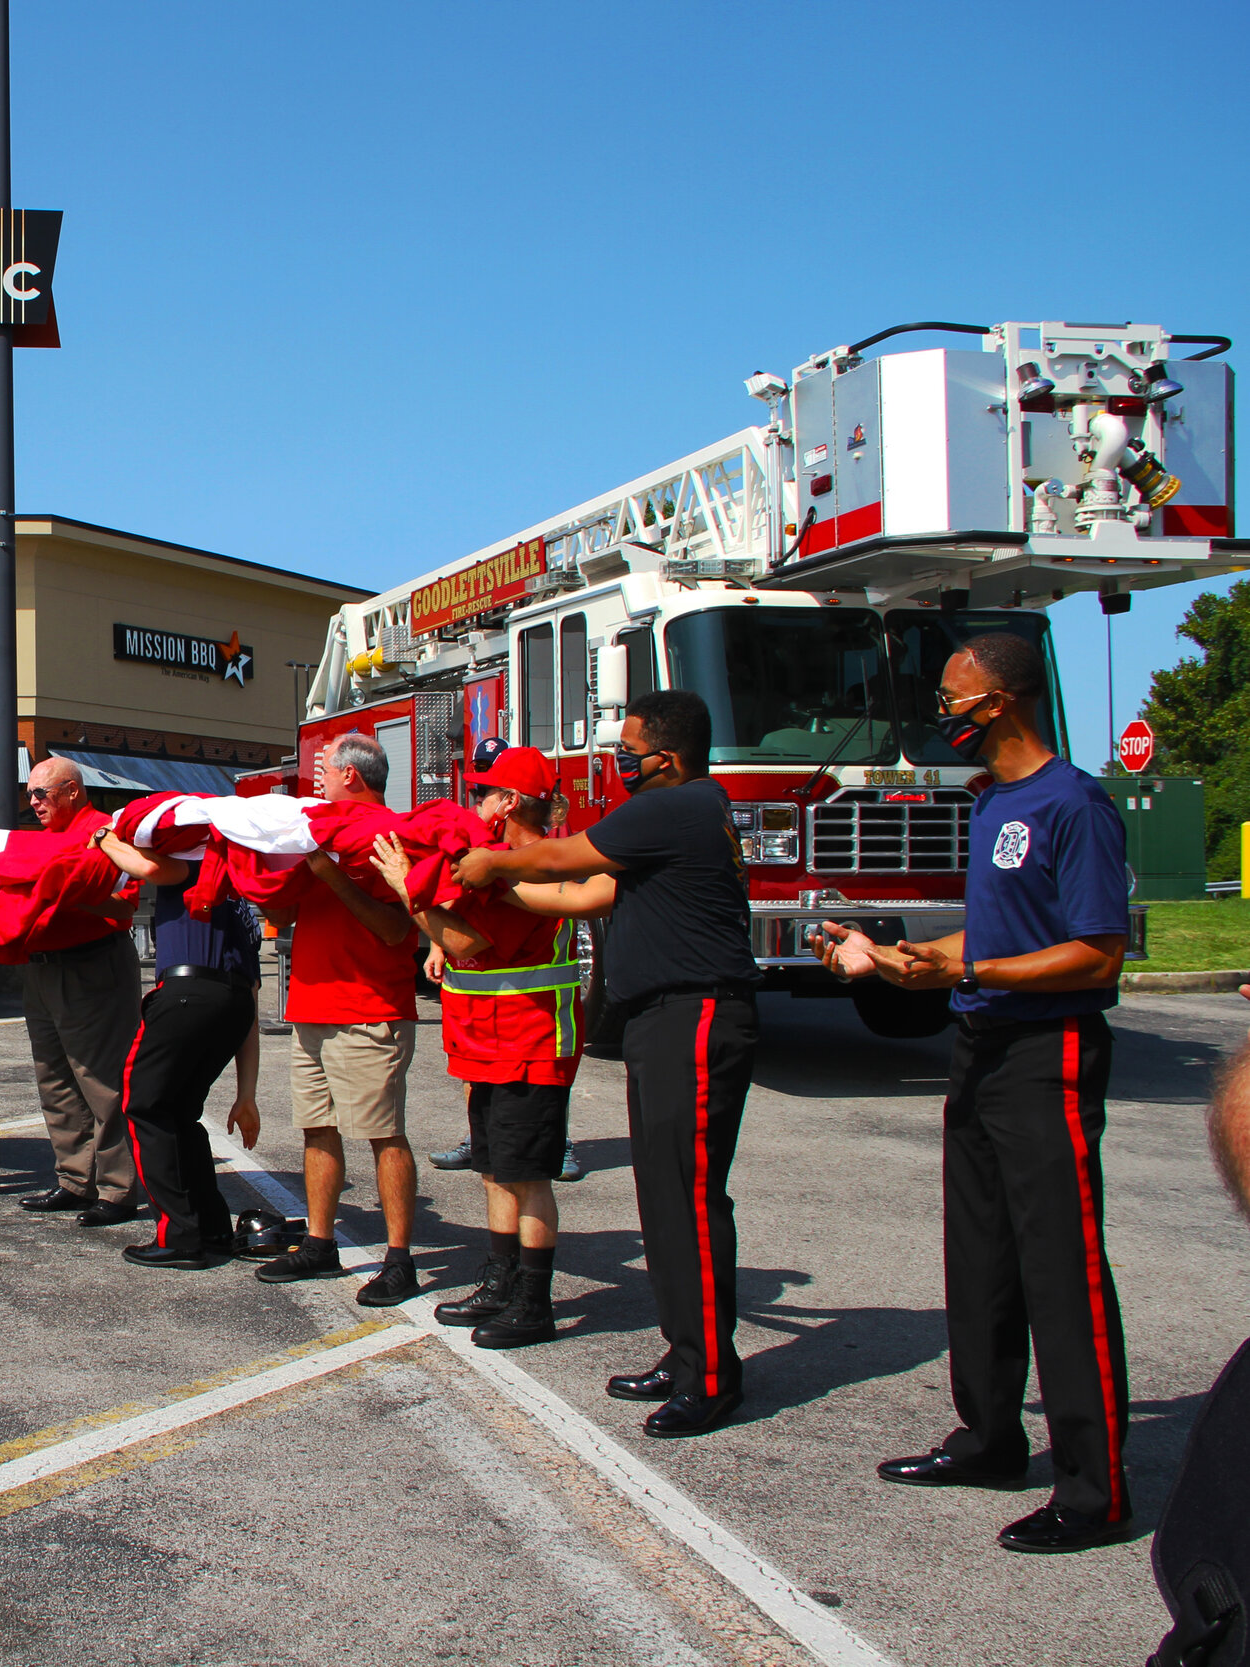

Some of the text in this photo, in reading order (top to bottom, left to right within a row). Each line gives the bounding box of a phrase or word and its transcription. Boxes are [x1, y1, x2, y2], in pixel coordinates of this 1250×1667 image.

[413, 540, 540, 619] GOODLETTSVILLE
[126, 629, 216, 670] MISSION BBQ
[173, 670, 198, 681] American
[1121, 737, 1150, 756] STOP
[864, 769, 941, 785] TOWER 41
